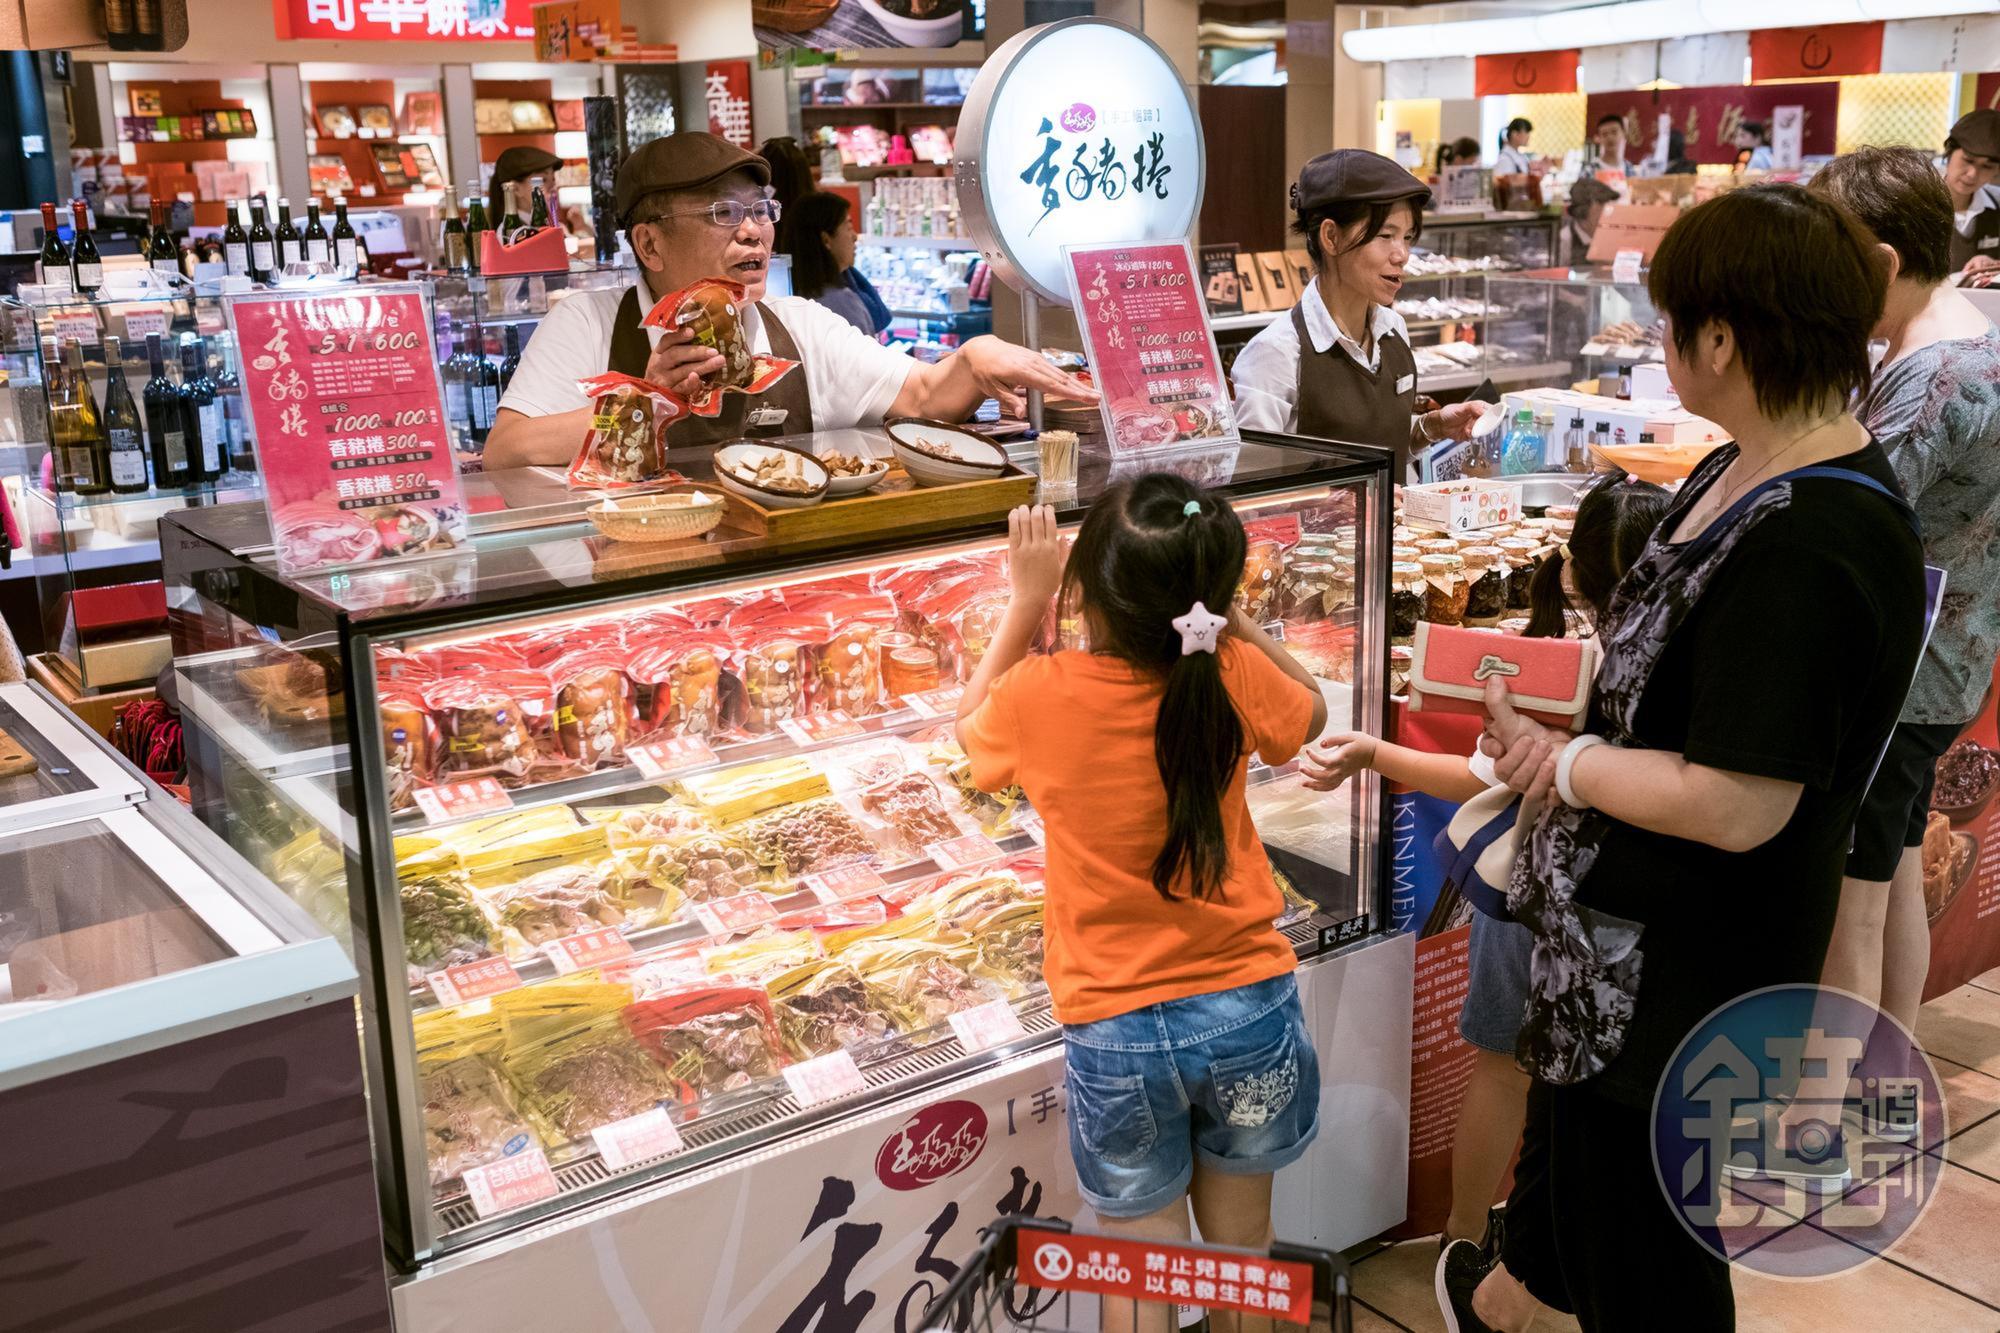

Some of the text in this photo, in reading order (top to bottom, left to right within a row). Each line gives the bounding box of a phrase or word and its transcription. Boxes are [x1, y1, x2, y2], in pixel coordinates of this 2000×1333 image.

[1077, 1264, 1131, 1284] SOGO
[1145, 1252, 1291, 1291] 禁止兒童乘坐
[1145, 1274, 1291, 1312] 以免發生危險
